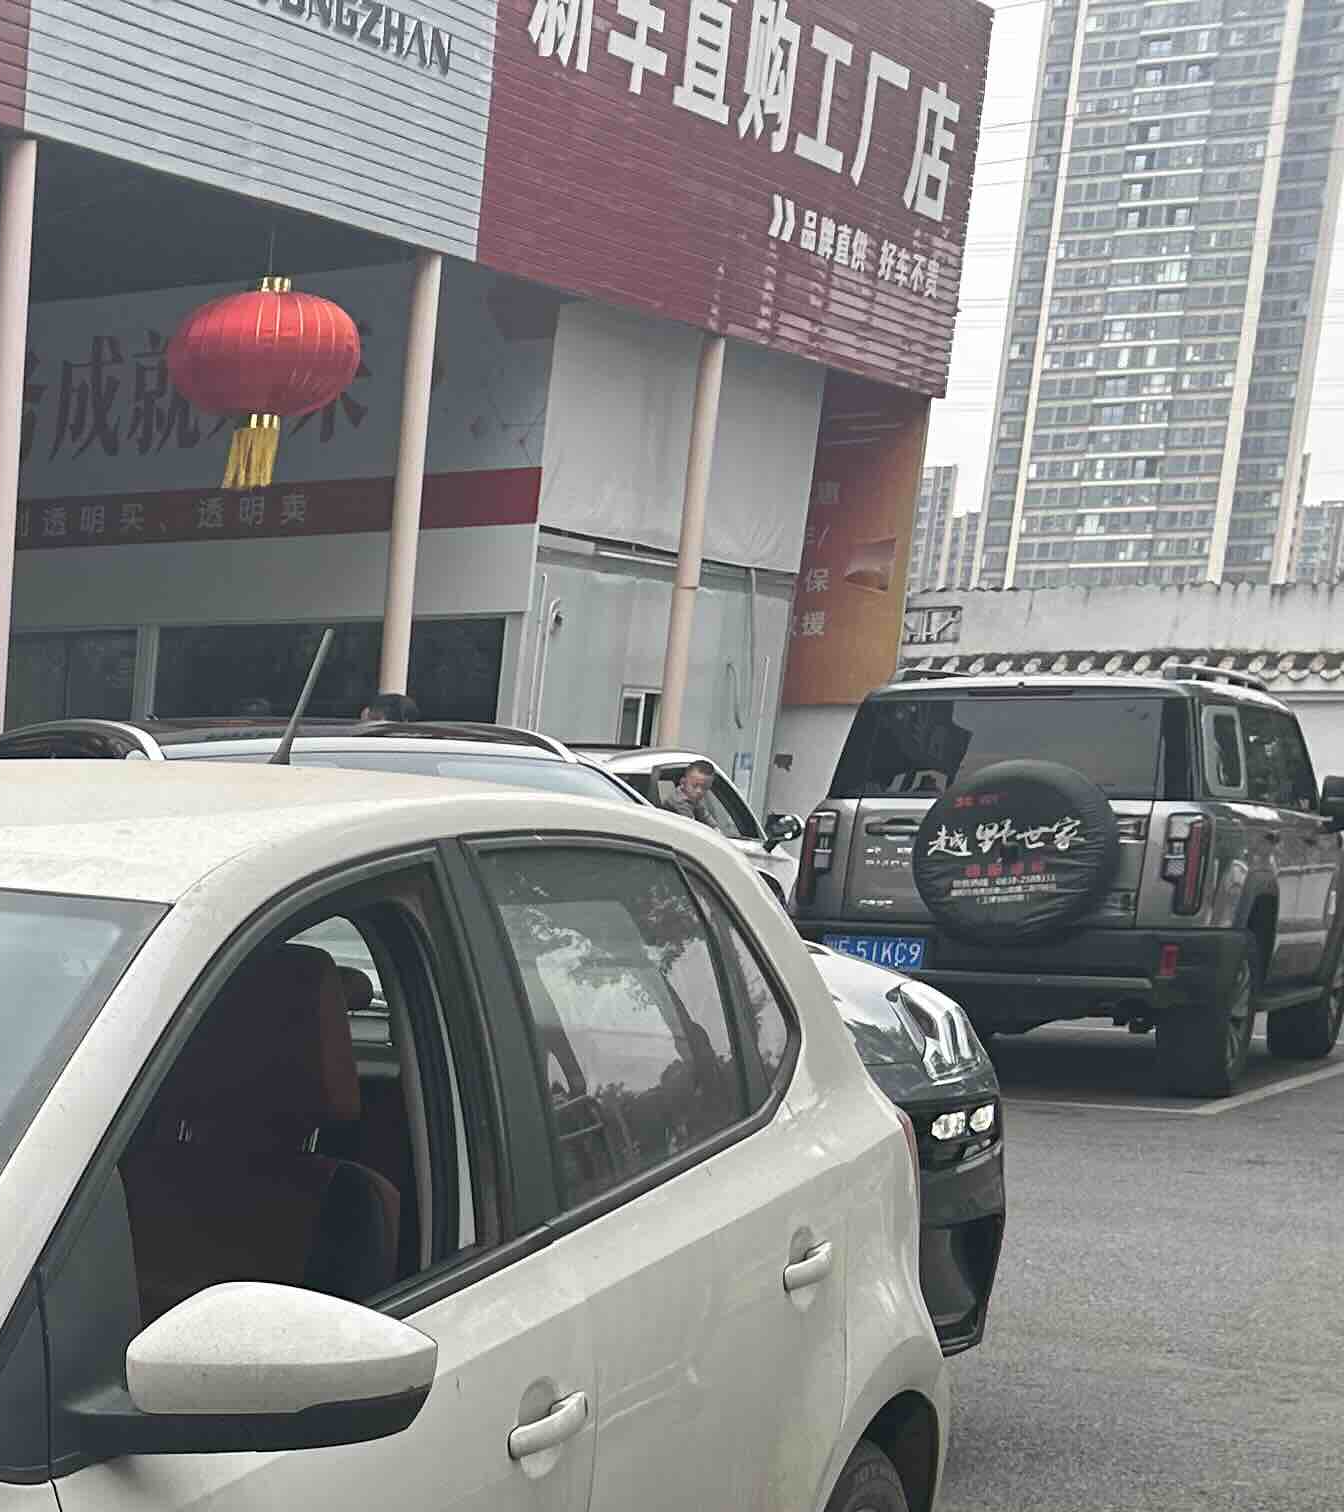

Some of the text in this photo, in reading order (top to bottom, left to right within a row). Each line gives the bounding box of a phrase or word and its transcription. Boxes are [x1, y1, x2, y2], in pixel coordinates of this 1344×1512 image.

[800, 209, 866, 273] 品牌直供
[928, 816, 1087, 857] 越野世家
